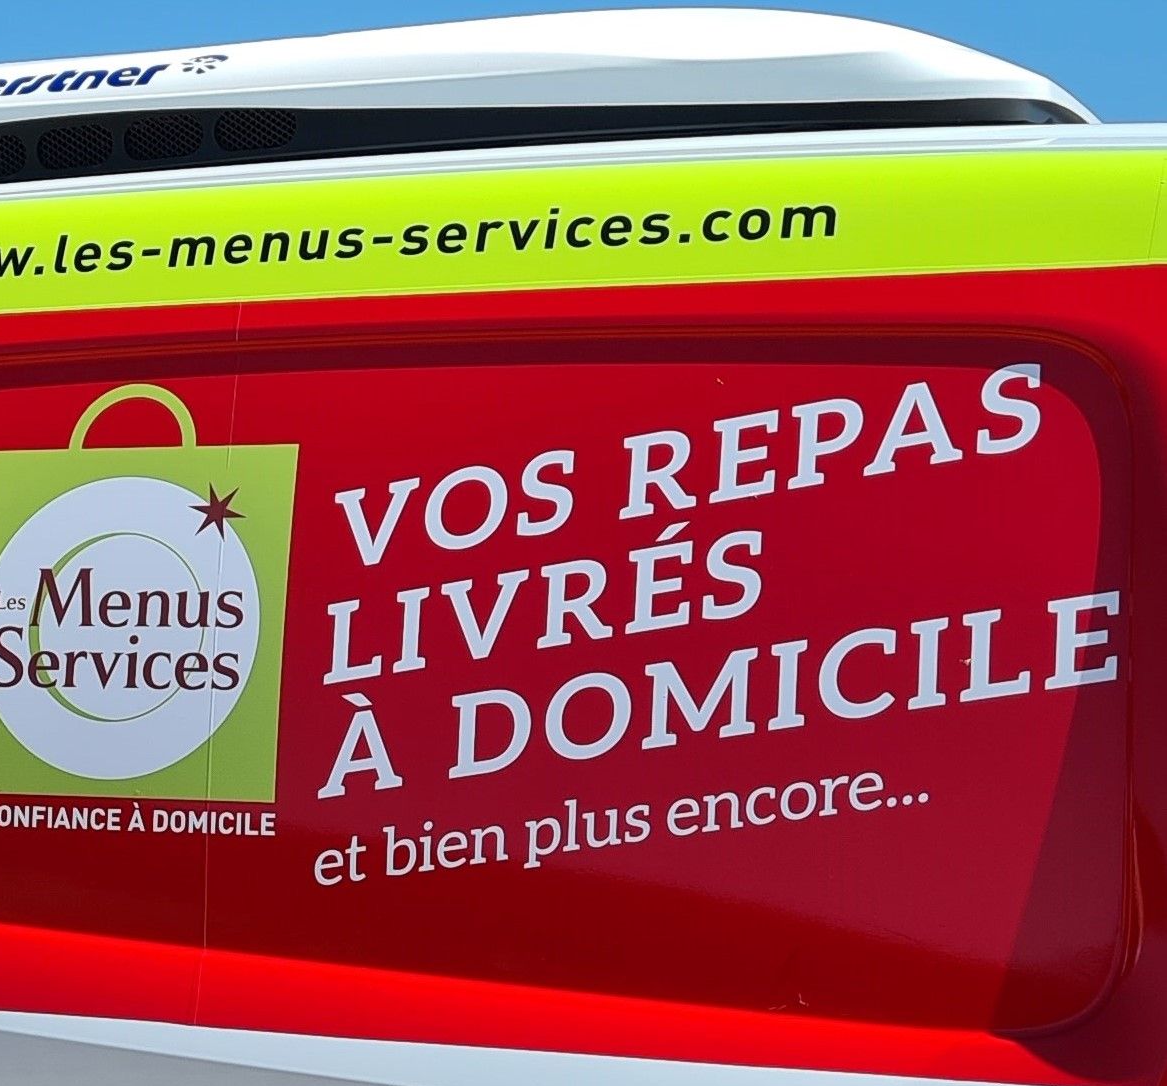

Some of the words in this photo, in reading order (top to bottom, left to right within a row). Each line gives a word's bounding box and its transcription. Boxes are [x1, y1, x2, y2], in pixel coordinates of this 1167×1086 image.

[335, 450, 574, 566] VOS
[619, 364, 1041, 520] REPAS
[29, 568, 243, 628] Menus
[323, 521, 762, 685] LIVRÉS
[318, 693, 402, 799] À
[448, 591, 1120, 780] DOMICILE
[128, 802, 145, 832] À
[152, 811, 276, 836] DOMICILE
[314, 836, 366, 886] et
[385, 820, 508, 876] bien
[524, 799, 650, 868] plus
[666, 772, 930, 834] encore...
